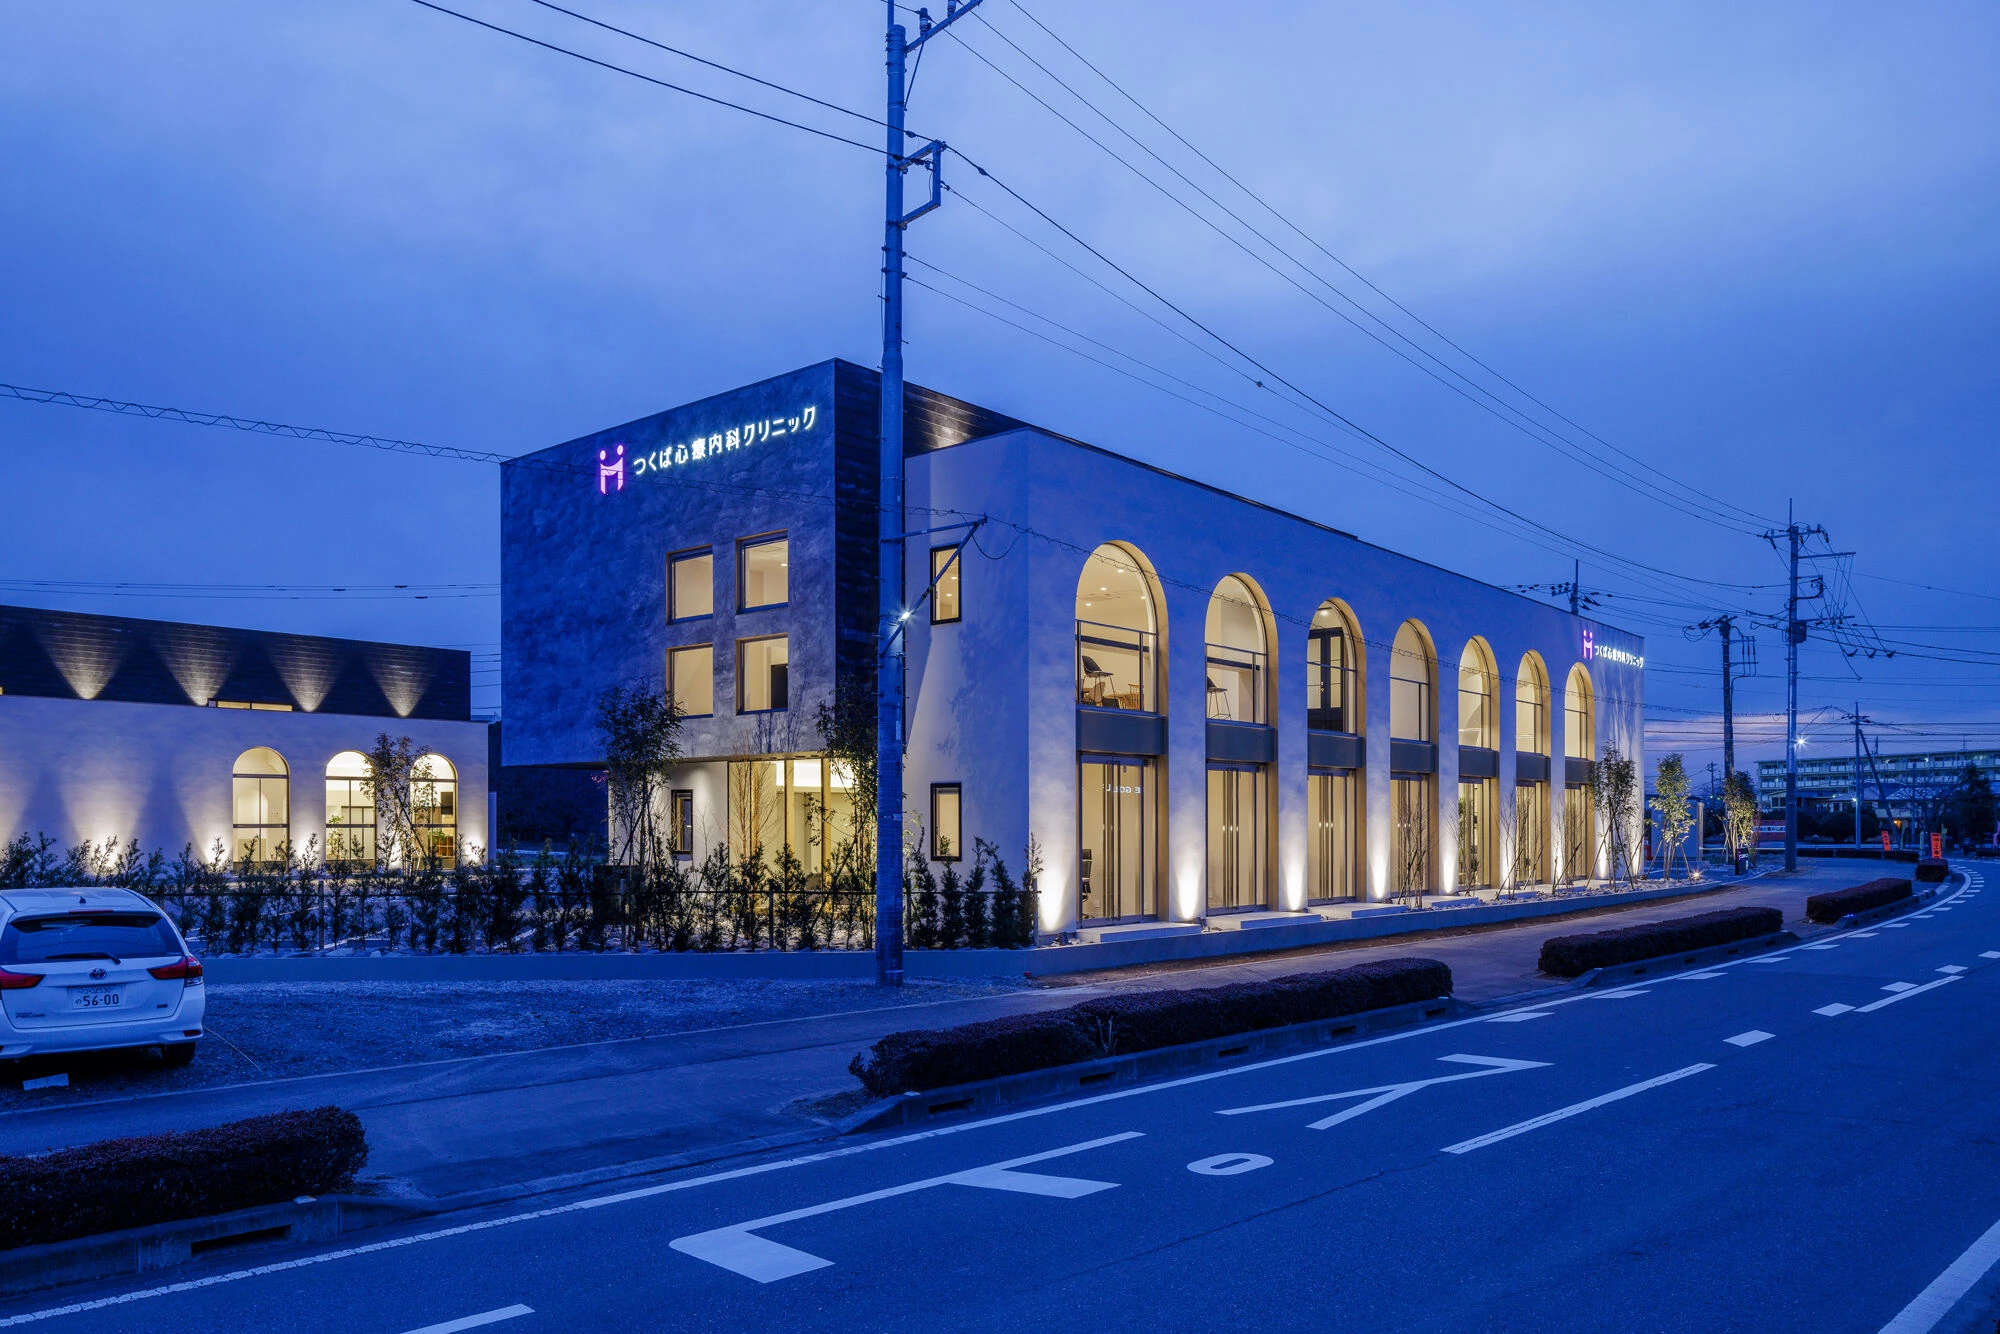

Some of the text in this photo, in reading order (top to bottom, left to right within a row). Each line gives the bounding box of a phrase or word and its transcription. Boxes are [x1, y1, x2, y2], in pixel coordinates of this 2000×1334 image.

[633, 406, 816, 475] つくば心療内科クリニック
[83, 993, 119, 1007] 56-00
